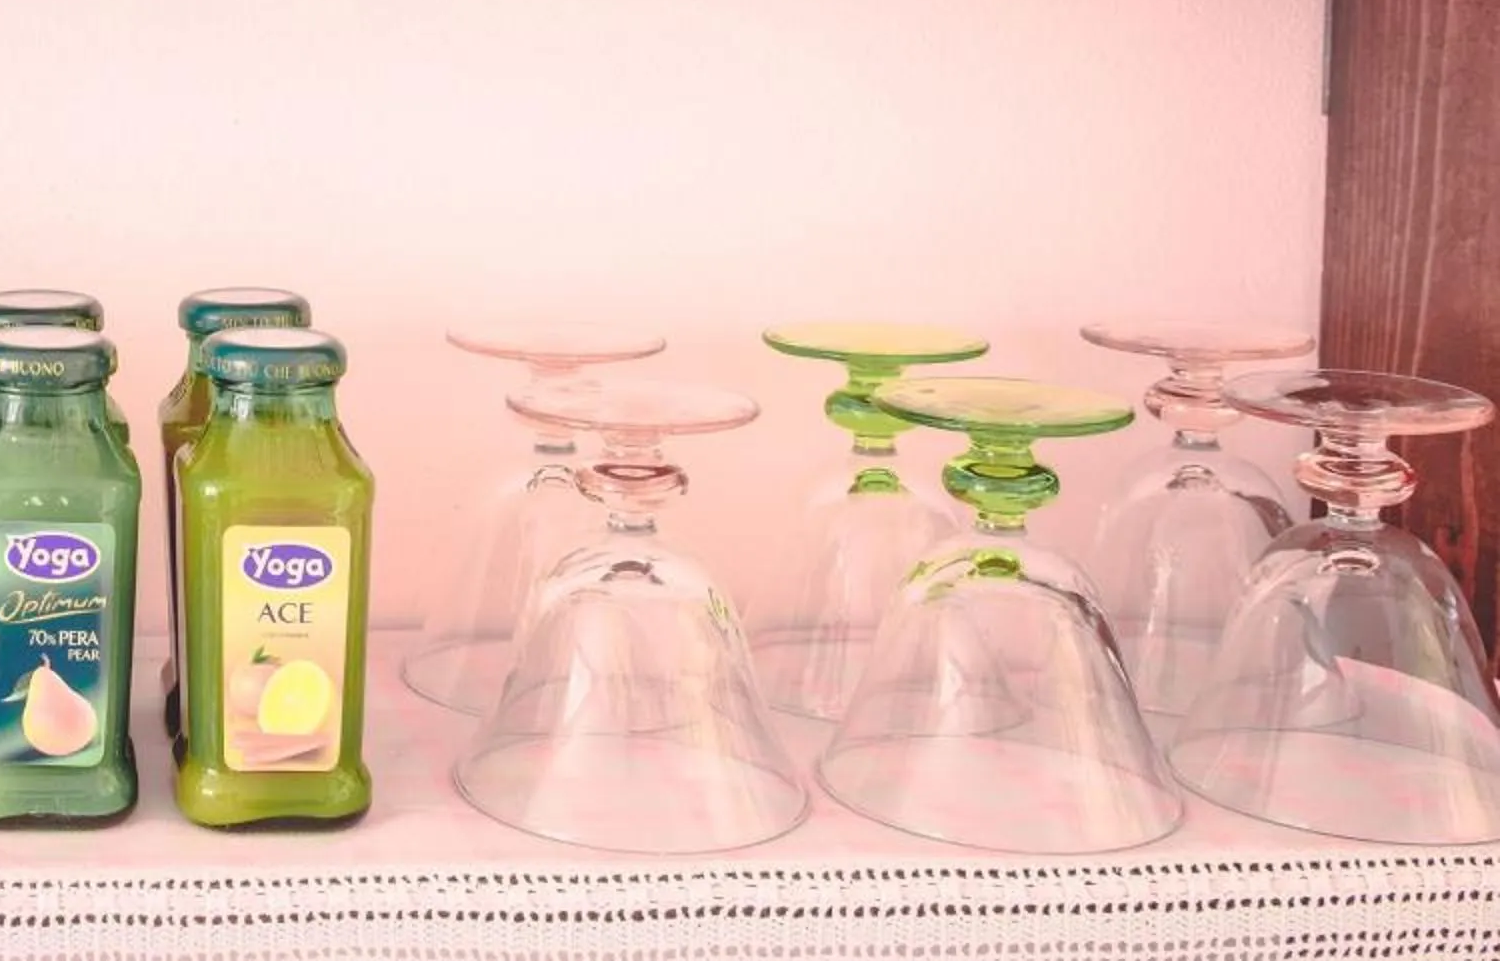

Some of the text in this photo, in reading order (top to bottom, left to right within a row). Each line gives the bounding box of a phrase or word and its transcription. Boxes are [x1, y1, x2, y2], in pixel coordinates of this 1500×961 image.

[8, 537, 90, 575] Yoga
[249, 546, 325, 585] Yoga
[258, 602, 314, 624] ACE
[59, 630, 99, 646] PERA
[67, 648, 100, 661] PEAR
